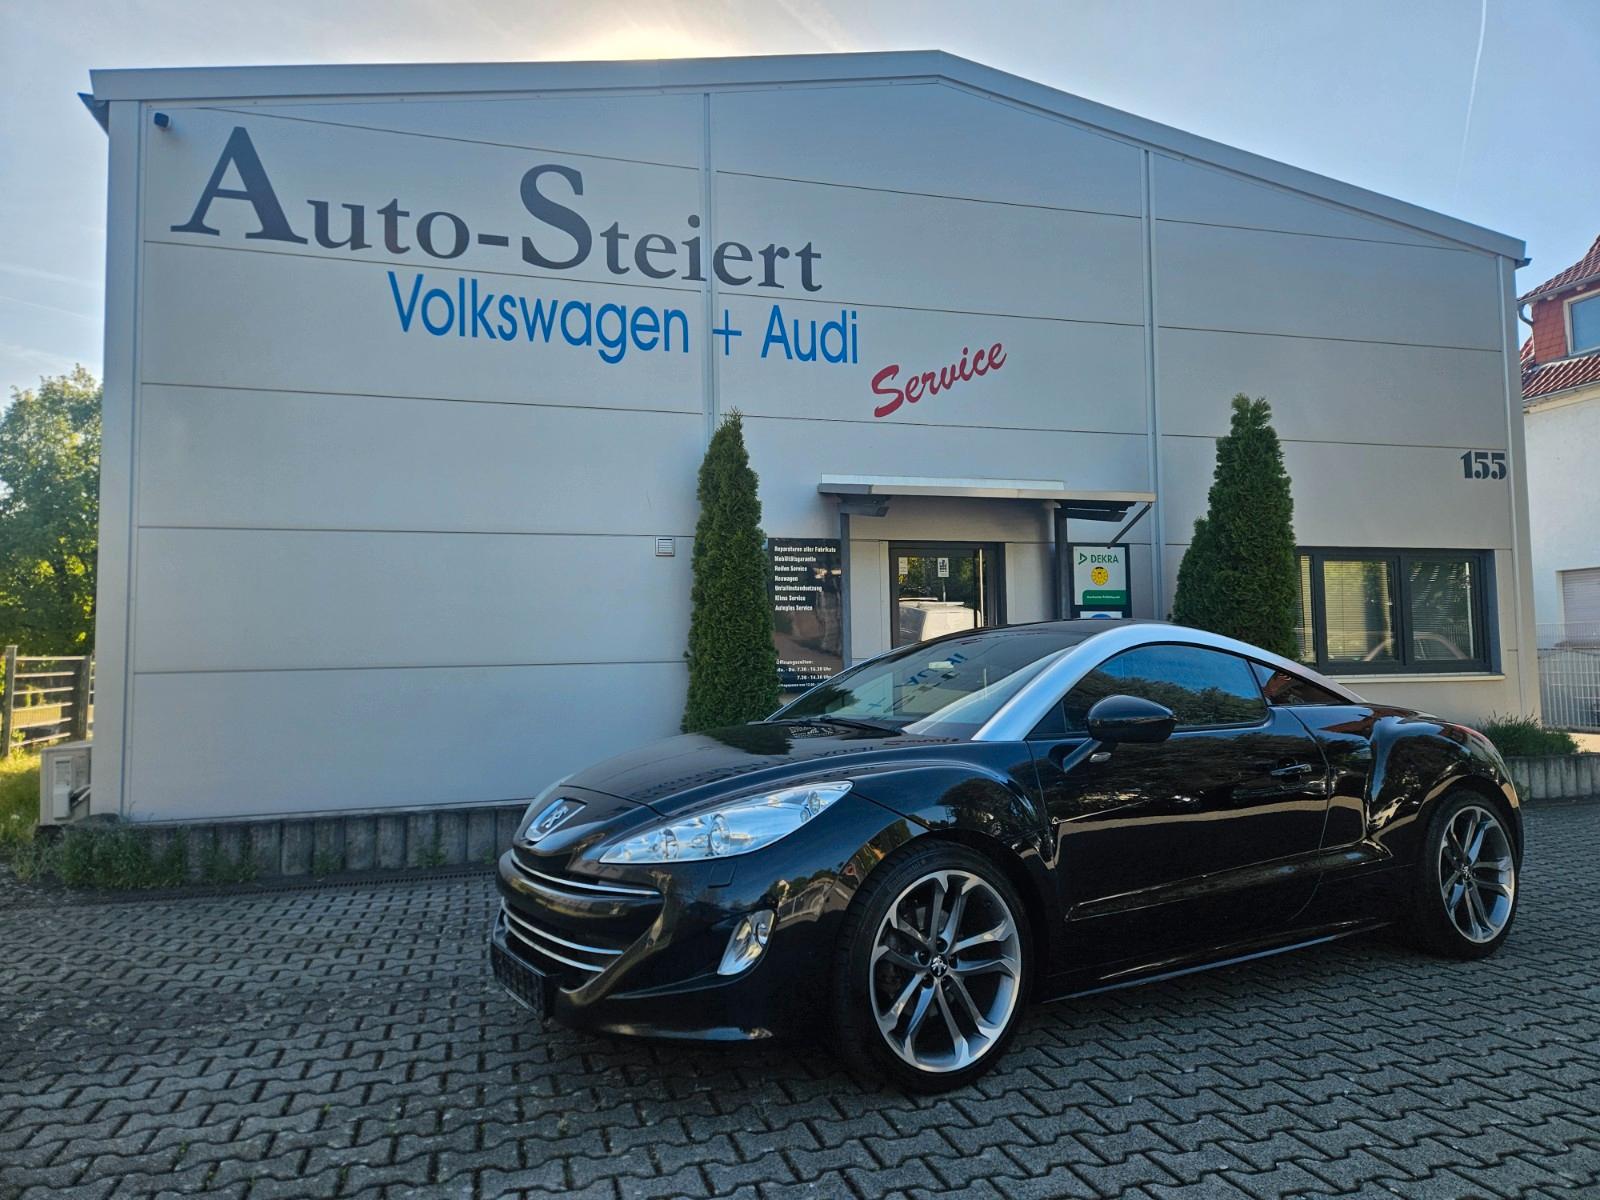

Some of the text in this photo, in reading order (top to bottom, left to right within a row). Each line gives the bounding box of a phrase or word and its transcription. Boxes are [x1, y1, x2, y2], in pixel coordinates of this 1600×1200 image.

[170, 126, 823, 292] Auto-Steiert
[387, 271, 689, 364] Volkswagen
[760, 304, 859, 364] Audi
[870, 341, 1007, 418] Service
[1460, 449, 1507, 480] 155
[1090, 554, 1119, 563] DEKRA
